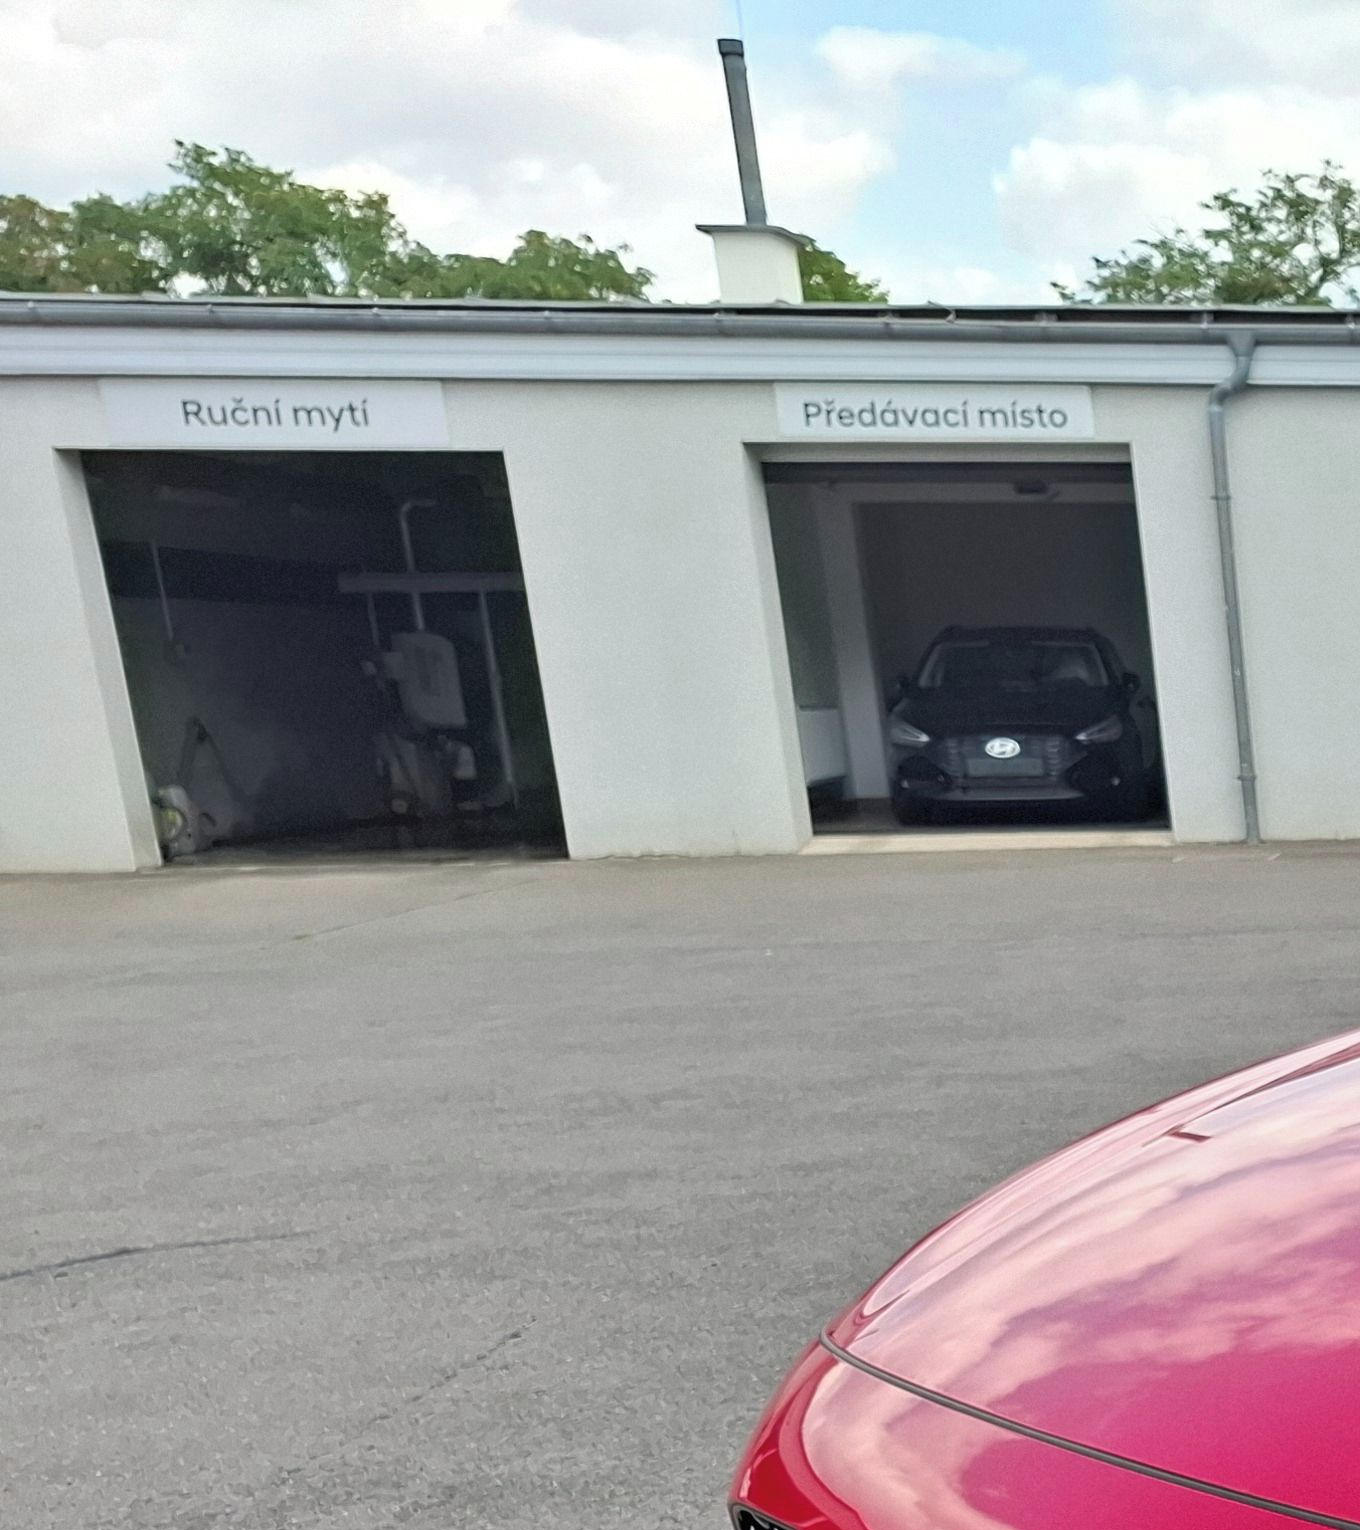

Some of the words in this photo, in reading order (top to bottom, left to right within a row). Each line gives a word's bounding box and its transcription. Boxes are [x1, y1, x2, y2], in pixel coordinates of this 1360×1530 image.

[181, 397, 282, 427] Ruční
[292, 398, 369, 432] mytí
[803, 399, 968, 428] Předávací
[979, 400, 1068, 428] místo
